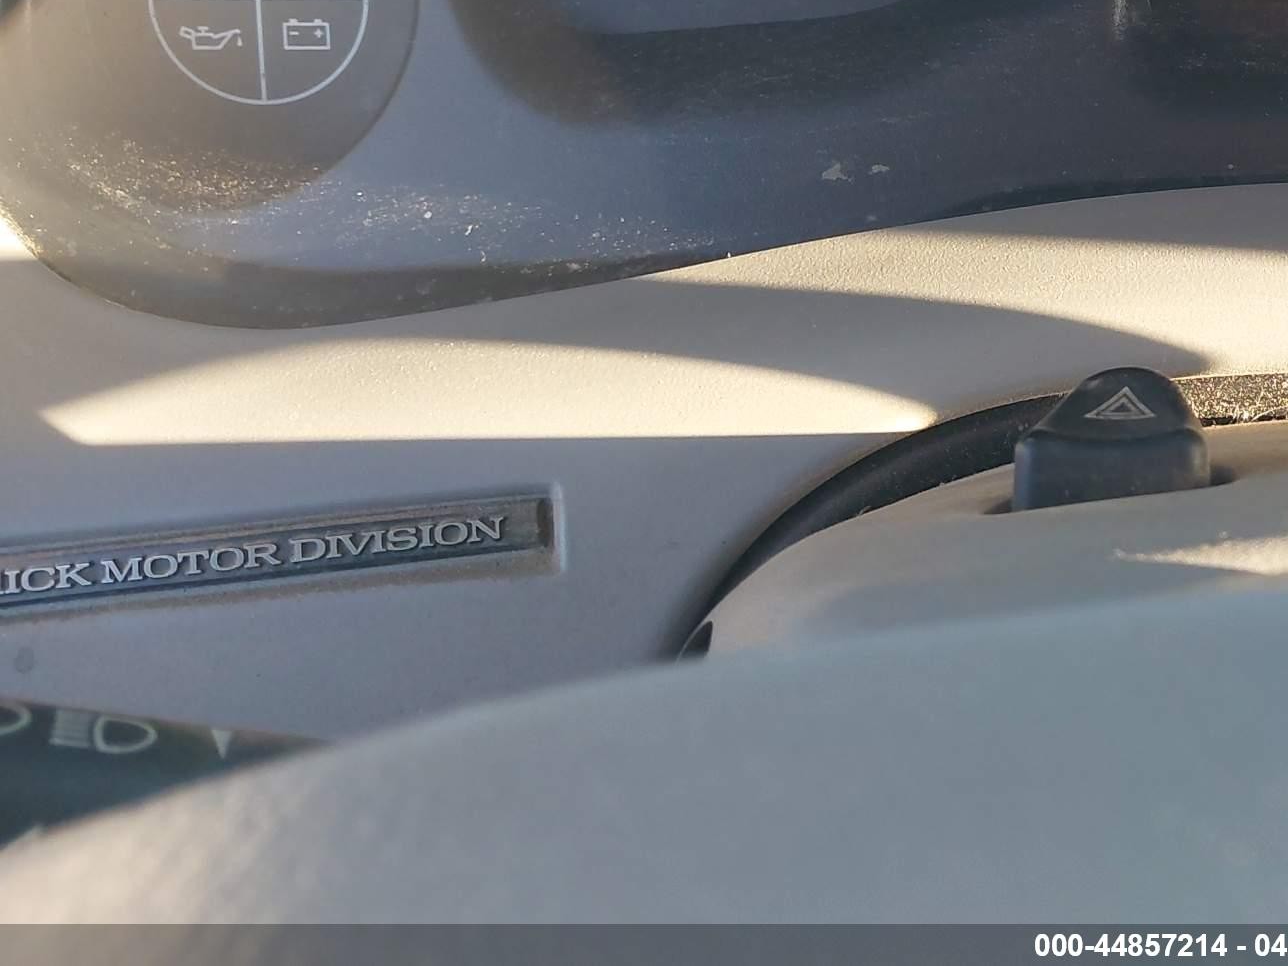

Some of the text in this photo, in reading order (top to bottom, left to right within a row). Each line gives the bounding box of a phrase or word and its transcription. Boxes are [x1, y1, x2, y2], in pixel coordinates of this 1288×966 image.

[0, 518, 504, 595] ICK MOTOR DIVISION
